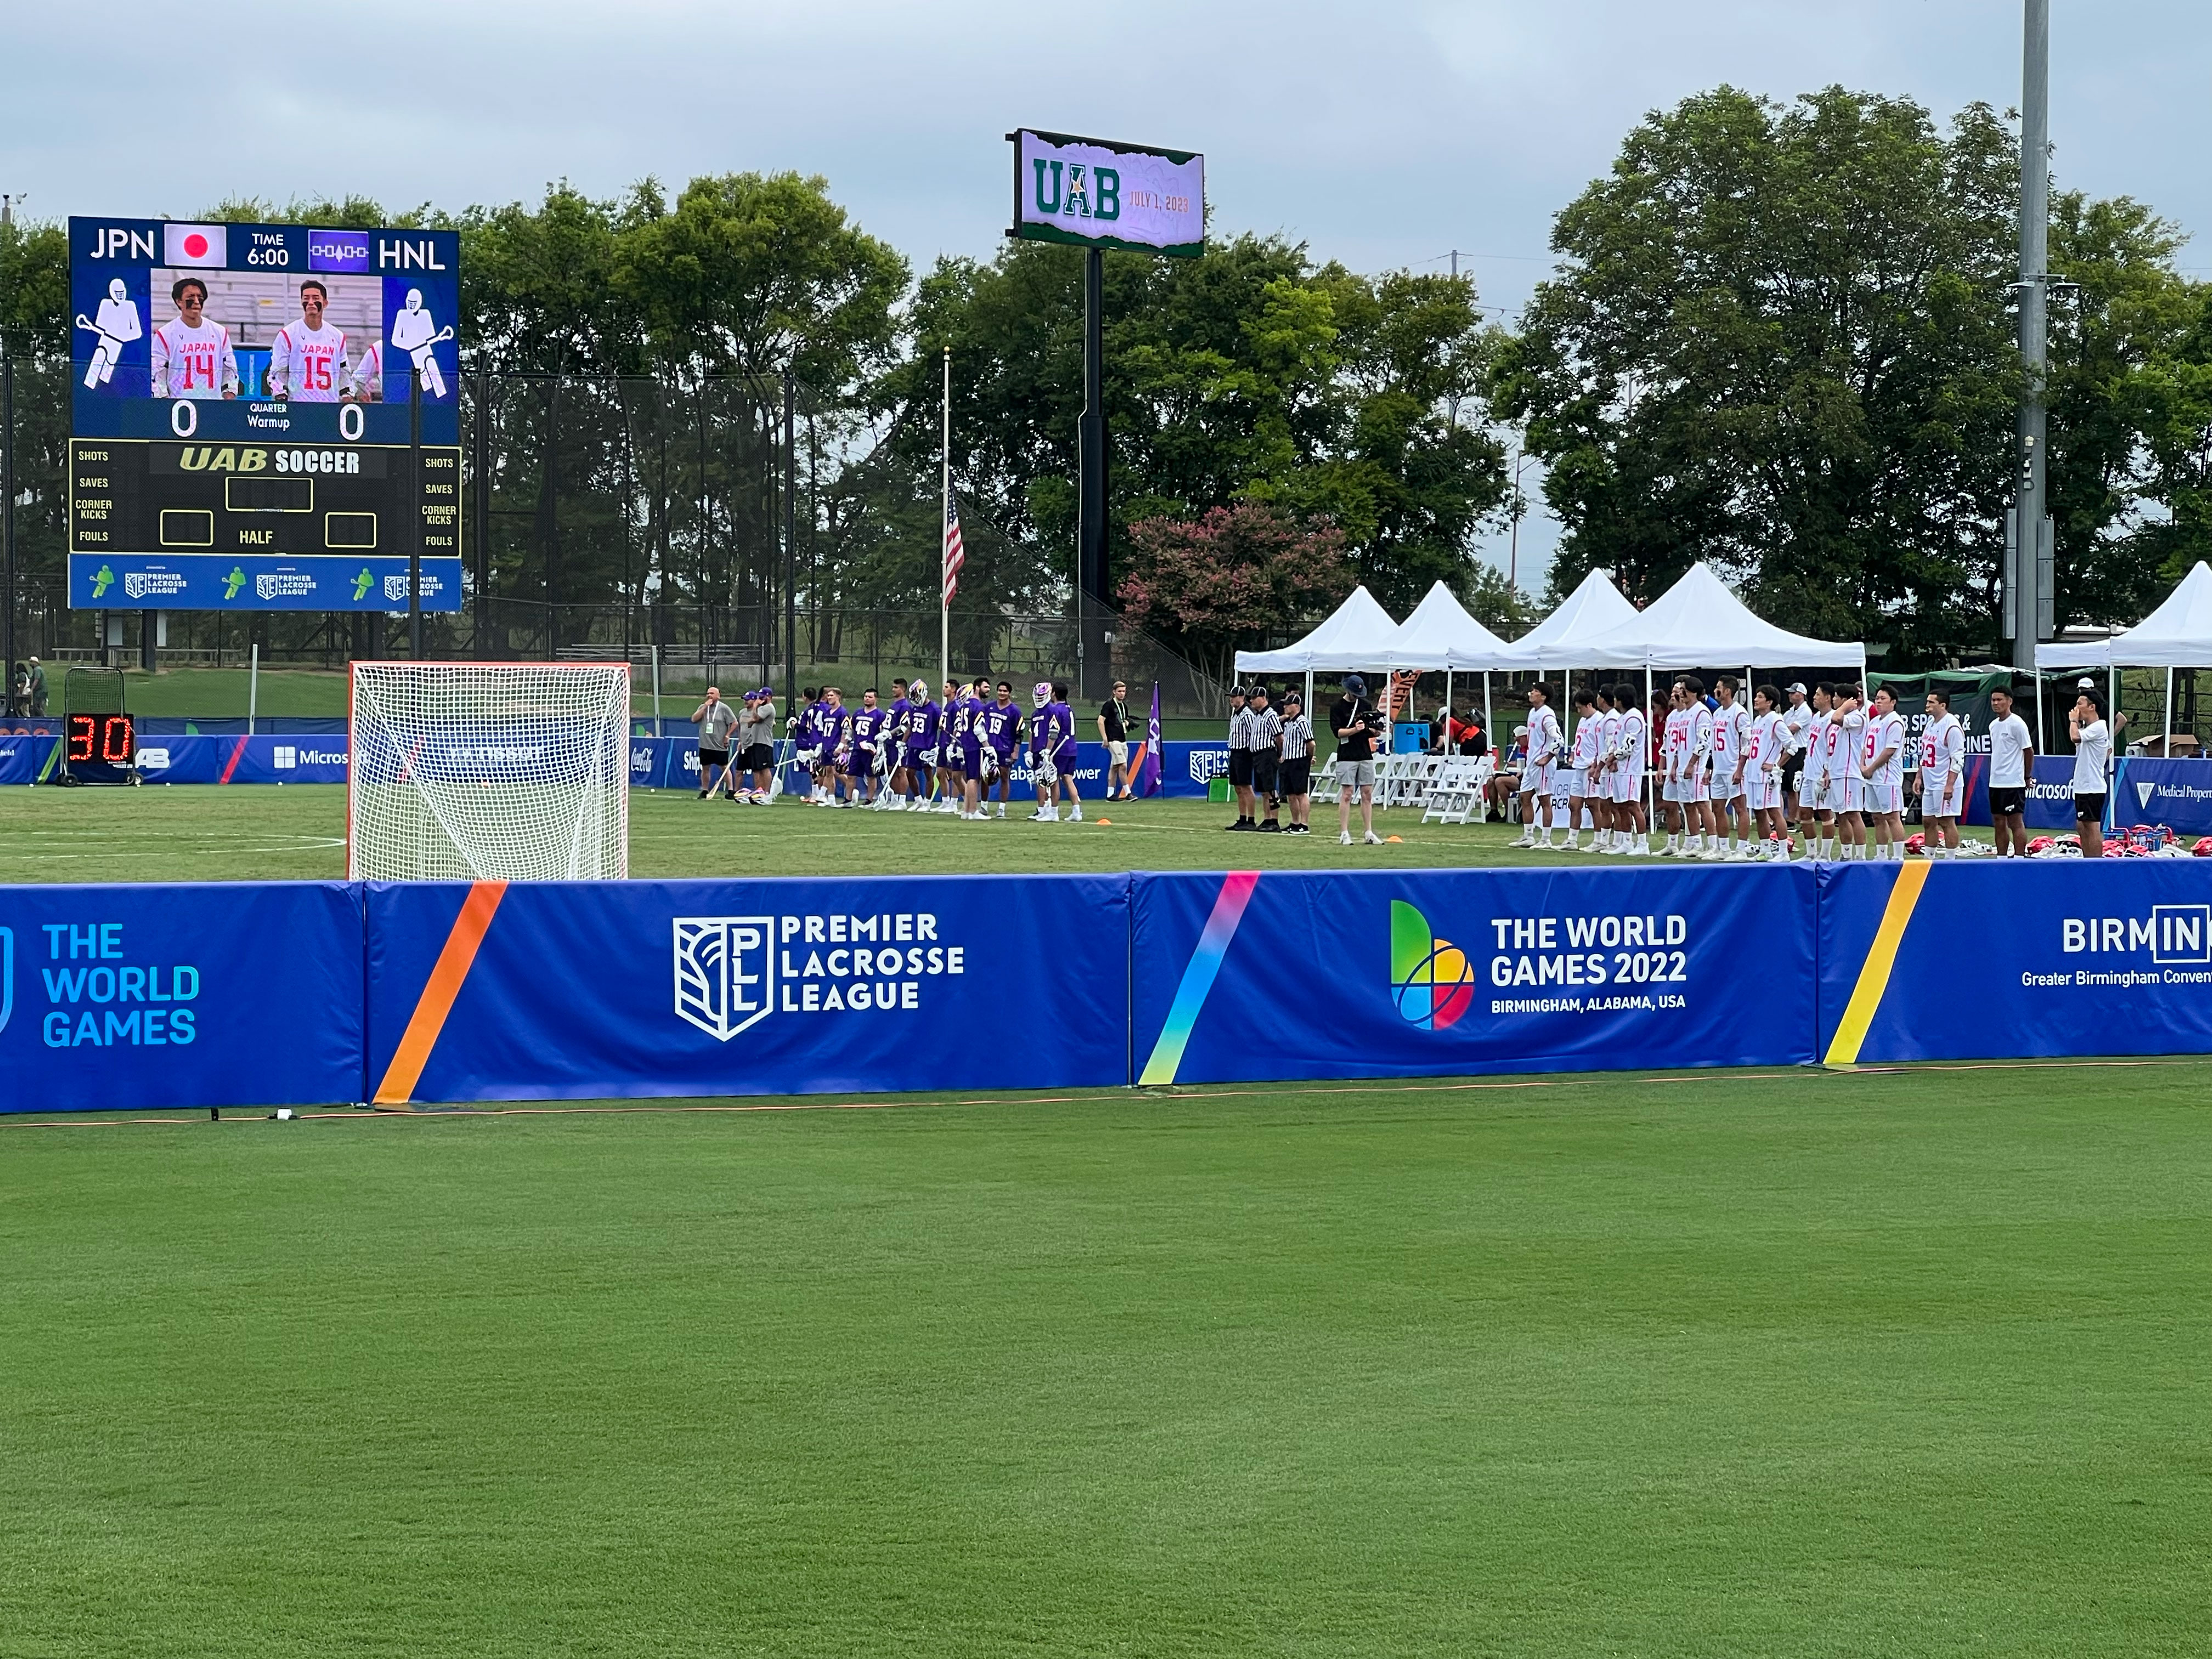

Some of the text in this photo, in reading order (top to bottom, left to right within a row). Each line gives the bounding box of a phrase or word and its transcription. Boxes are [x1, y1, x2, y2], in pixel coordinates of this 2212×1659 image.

[1034, 159, 1120, 221] UAB
[1130, 191, 1150, 208] JULY
[90, 228, 154, 259] JPN
[252, 233, 284, 246] TIME
[247, 249, 289, 266] 6:00
[379, 239, 445, 270] HNL
[179, 343, 216, 353] JAPAN
[301, 345, 335, 356] JAPAN
[183, 354, 214, 390] 14
[303, 356, 332, 390] 15
[250, 403, 287, 413] QUARTER
[172, 400, 197, 438] 0
[247, 414, 290, 431] Warmup
[340, 403, 364, 441] 0
[78, 451, 109, 461] SHOTS
[180, 447, 359, 473] UAB SOCCER
[425, 458, 454, 468] SHOTS
[80, 478, 109, 488] SAVES
[426, 484, 453, 494] SAVES
[75, 500, 112, 509] CORNER
[422, 505, 456, 515] CORNER
[81, 510, 107, 520] KICKS
[427, 515, 452, 524] KICKS
[80, 531, 109, 541] FOULS
[239, 530, 273, 544] HALF
[426, 536, 453, 546] FOULS
[823, 722, 834, 737] 17
[855, 721, 870, 736] 45
[912, 717, 925, 733] 33
[989, 717, 1003, 735] 19
[1033, 721, 1039, 737] 4
[69, 716, 131, 760] 30
[135, 748, 171, 769] AB
[300, 750, 348, 764] Micros
[684, 751, 703, 776] Ship
[2157, 784, 2185, 797] Medical
[781, 914, 938, 943] PREMIER
[1491, 915, 1686, 949] THE WORLD
[2063, 917, 2212, 953] BIRMIN
[42, 923, 123, 960] THE
[782, 947, 964, 978] LACROSSE
[1491, 951, 1686, 986] GAMES 2022
[42, 966, 200, 1003] WORLD
[2022, 971, 2072, 986] Greater
[2076, 970, 2160, 988] Birmingham
[782, 982, 919, 1012] LEAGUE
[1492, 995, 1686, 1014] BIRMINGHAM, ALABAMA, USA
[43, 1009, 196, 1047] GAMES
